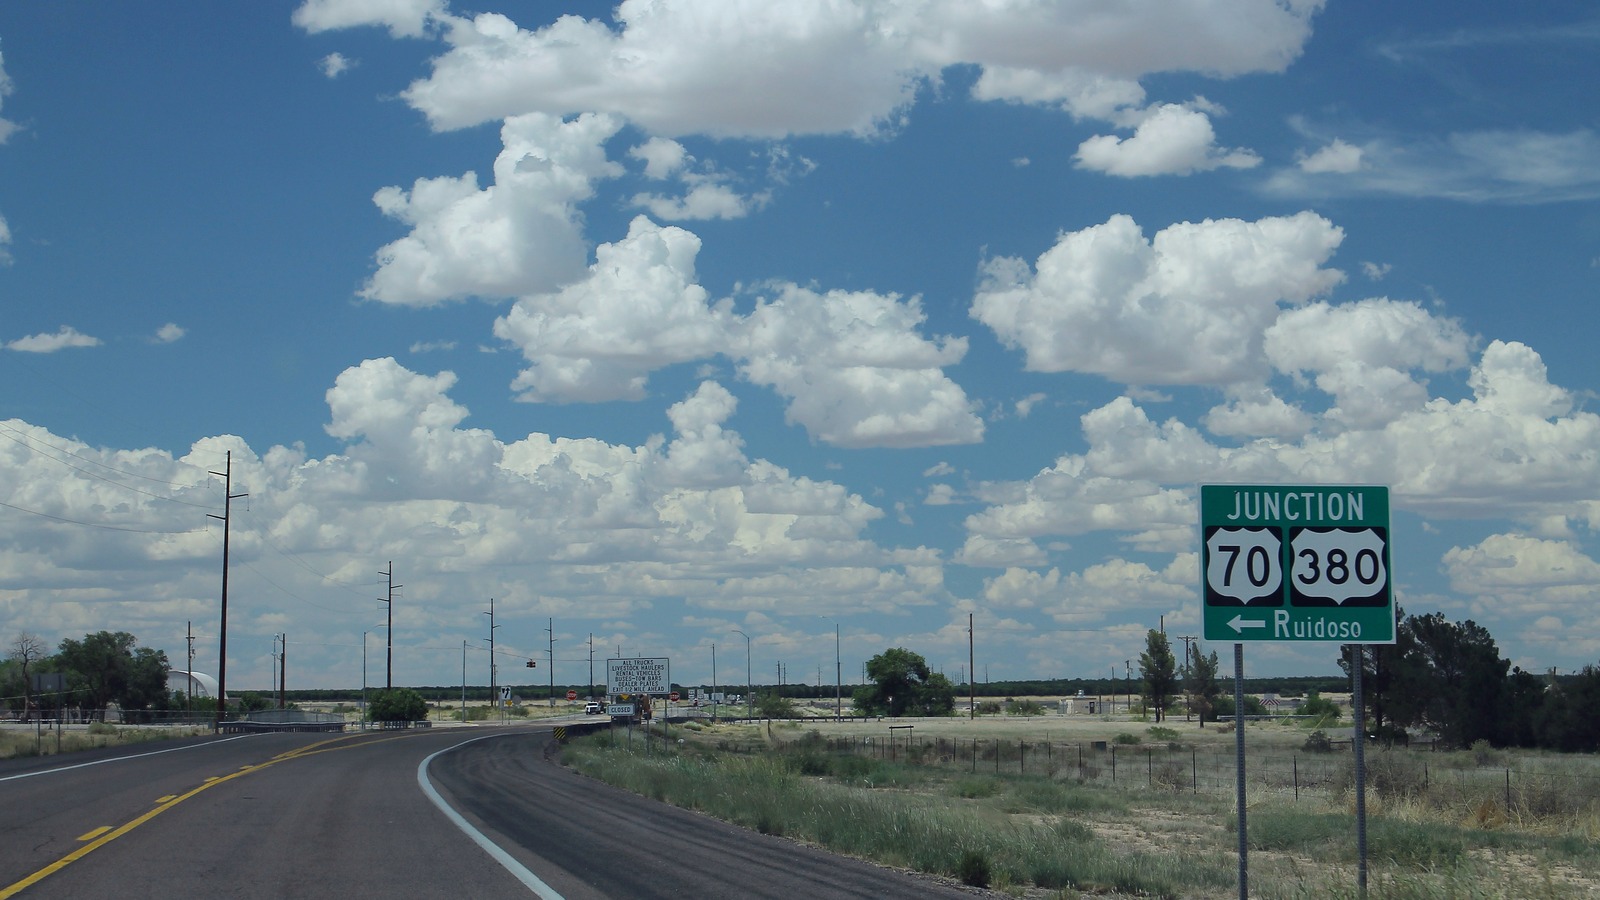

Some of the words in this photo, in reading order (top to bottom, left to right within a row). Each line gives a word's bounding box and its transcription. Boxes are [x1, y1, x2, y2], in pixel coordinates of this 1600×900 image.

[1227, 490, 1364, 520] JUNCTION
[1218, 545, 1270, 587] 70
[1297, 548, 1379, 585] 380
[1274, 609, 1362, 638] Ruidoso
